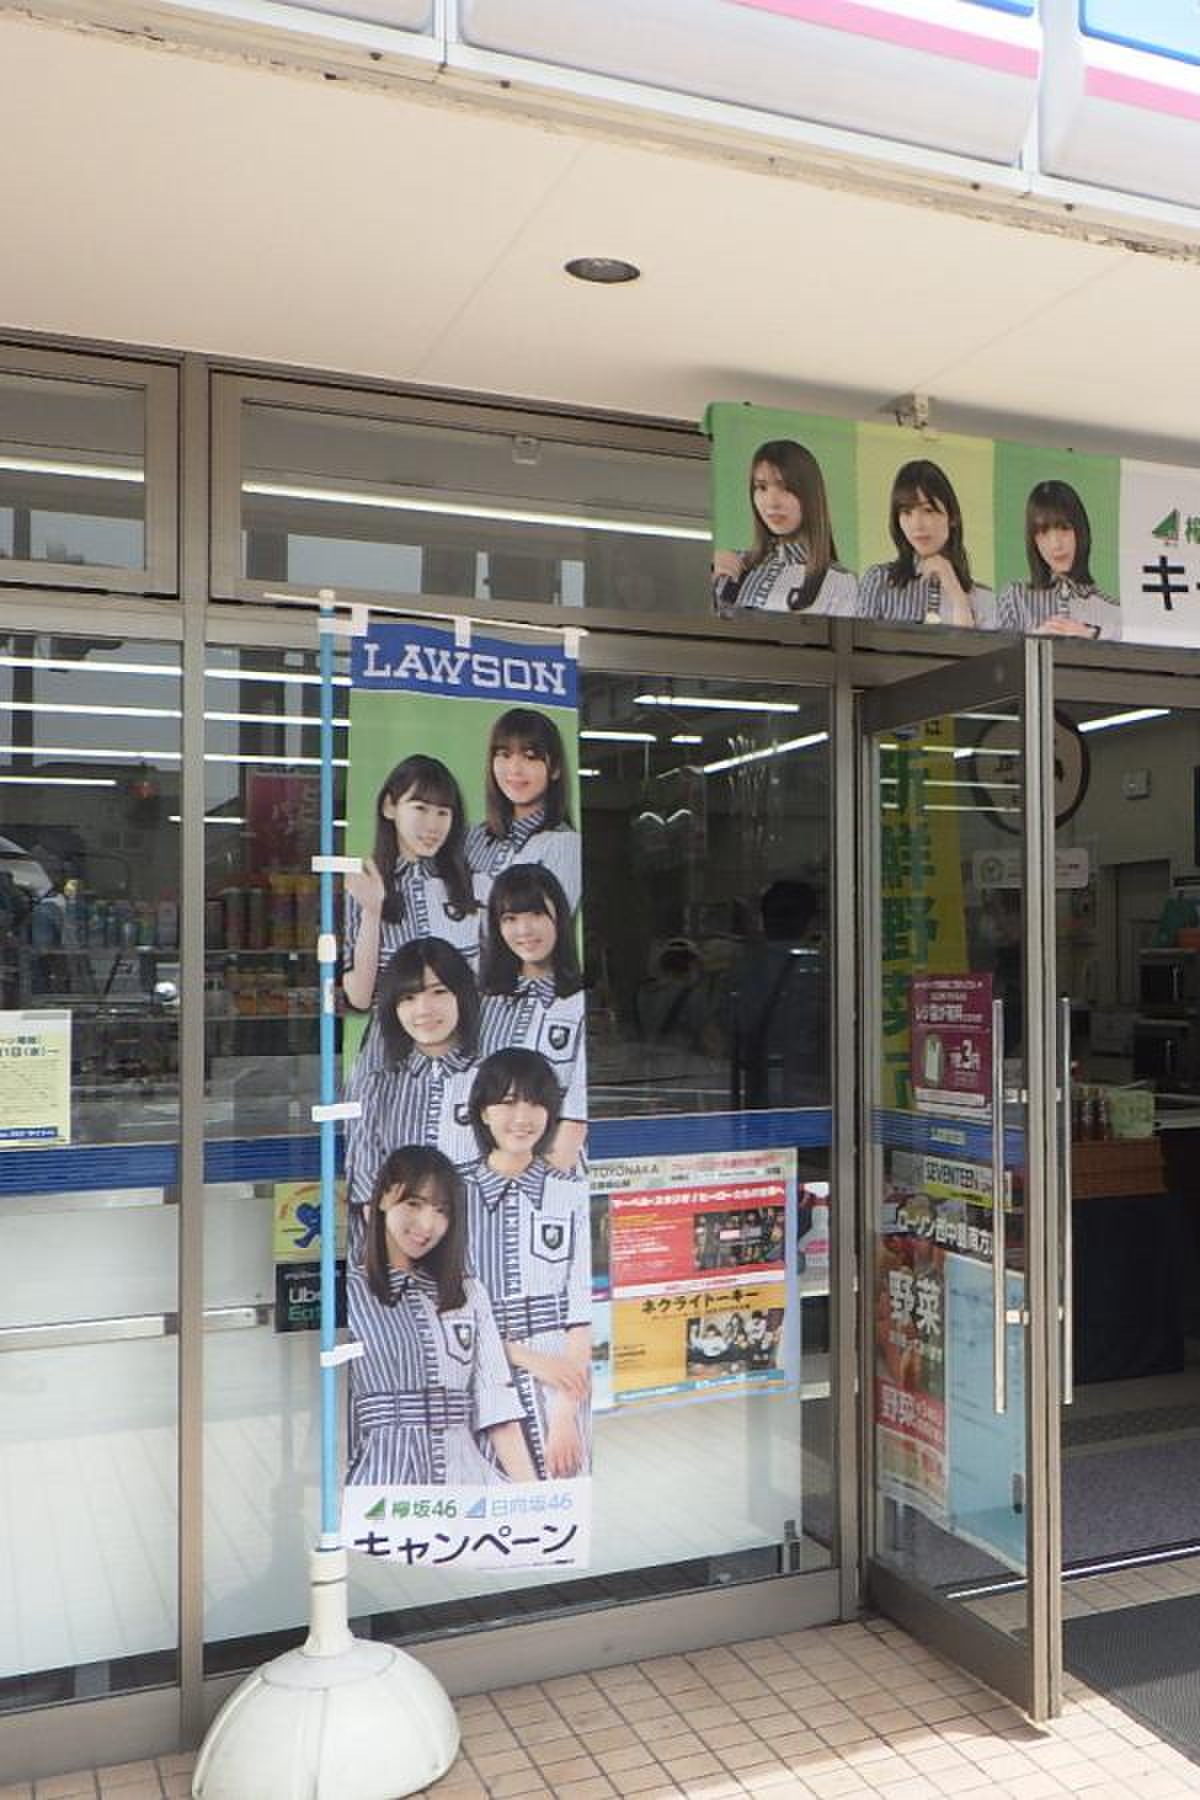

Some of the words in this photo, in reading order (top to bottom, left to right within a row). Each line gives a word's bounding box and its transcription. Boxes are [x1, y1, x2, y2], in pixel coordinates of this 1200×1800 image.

[363, 643, 567, 696] LAWSON
[641, 1288, 760, 1313] ネクライトーキー
[888, 1269, 943, 1337] 野菜
[353, 1523, 578, 1566] キャンペーン
